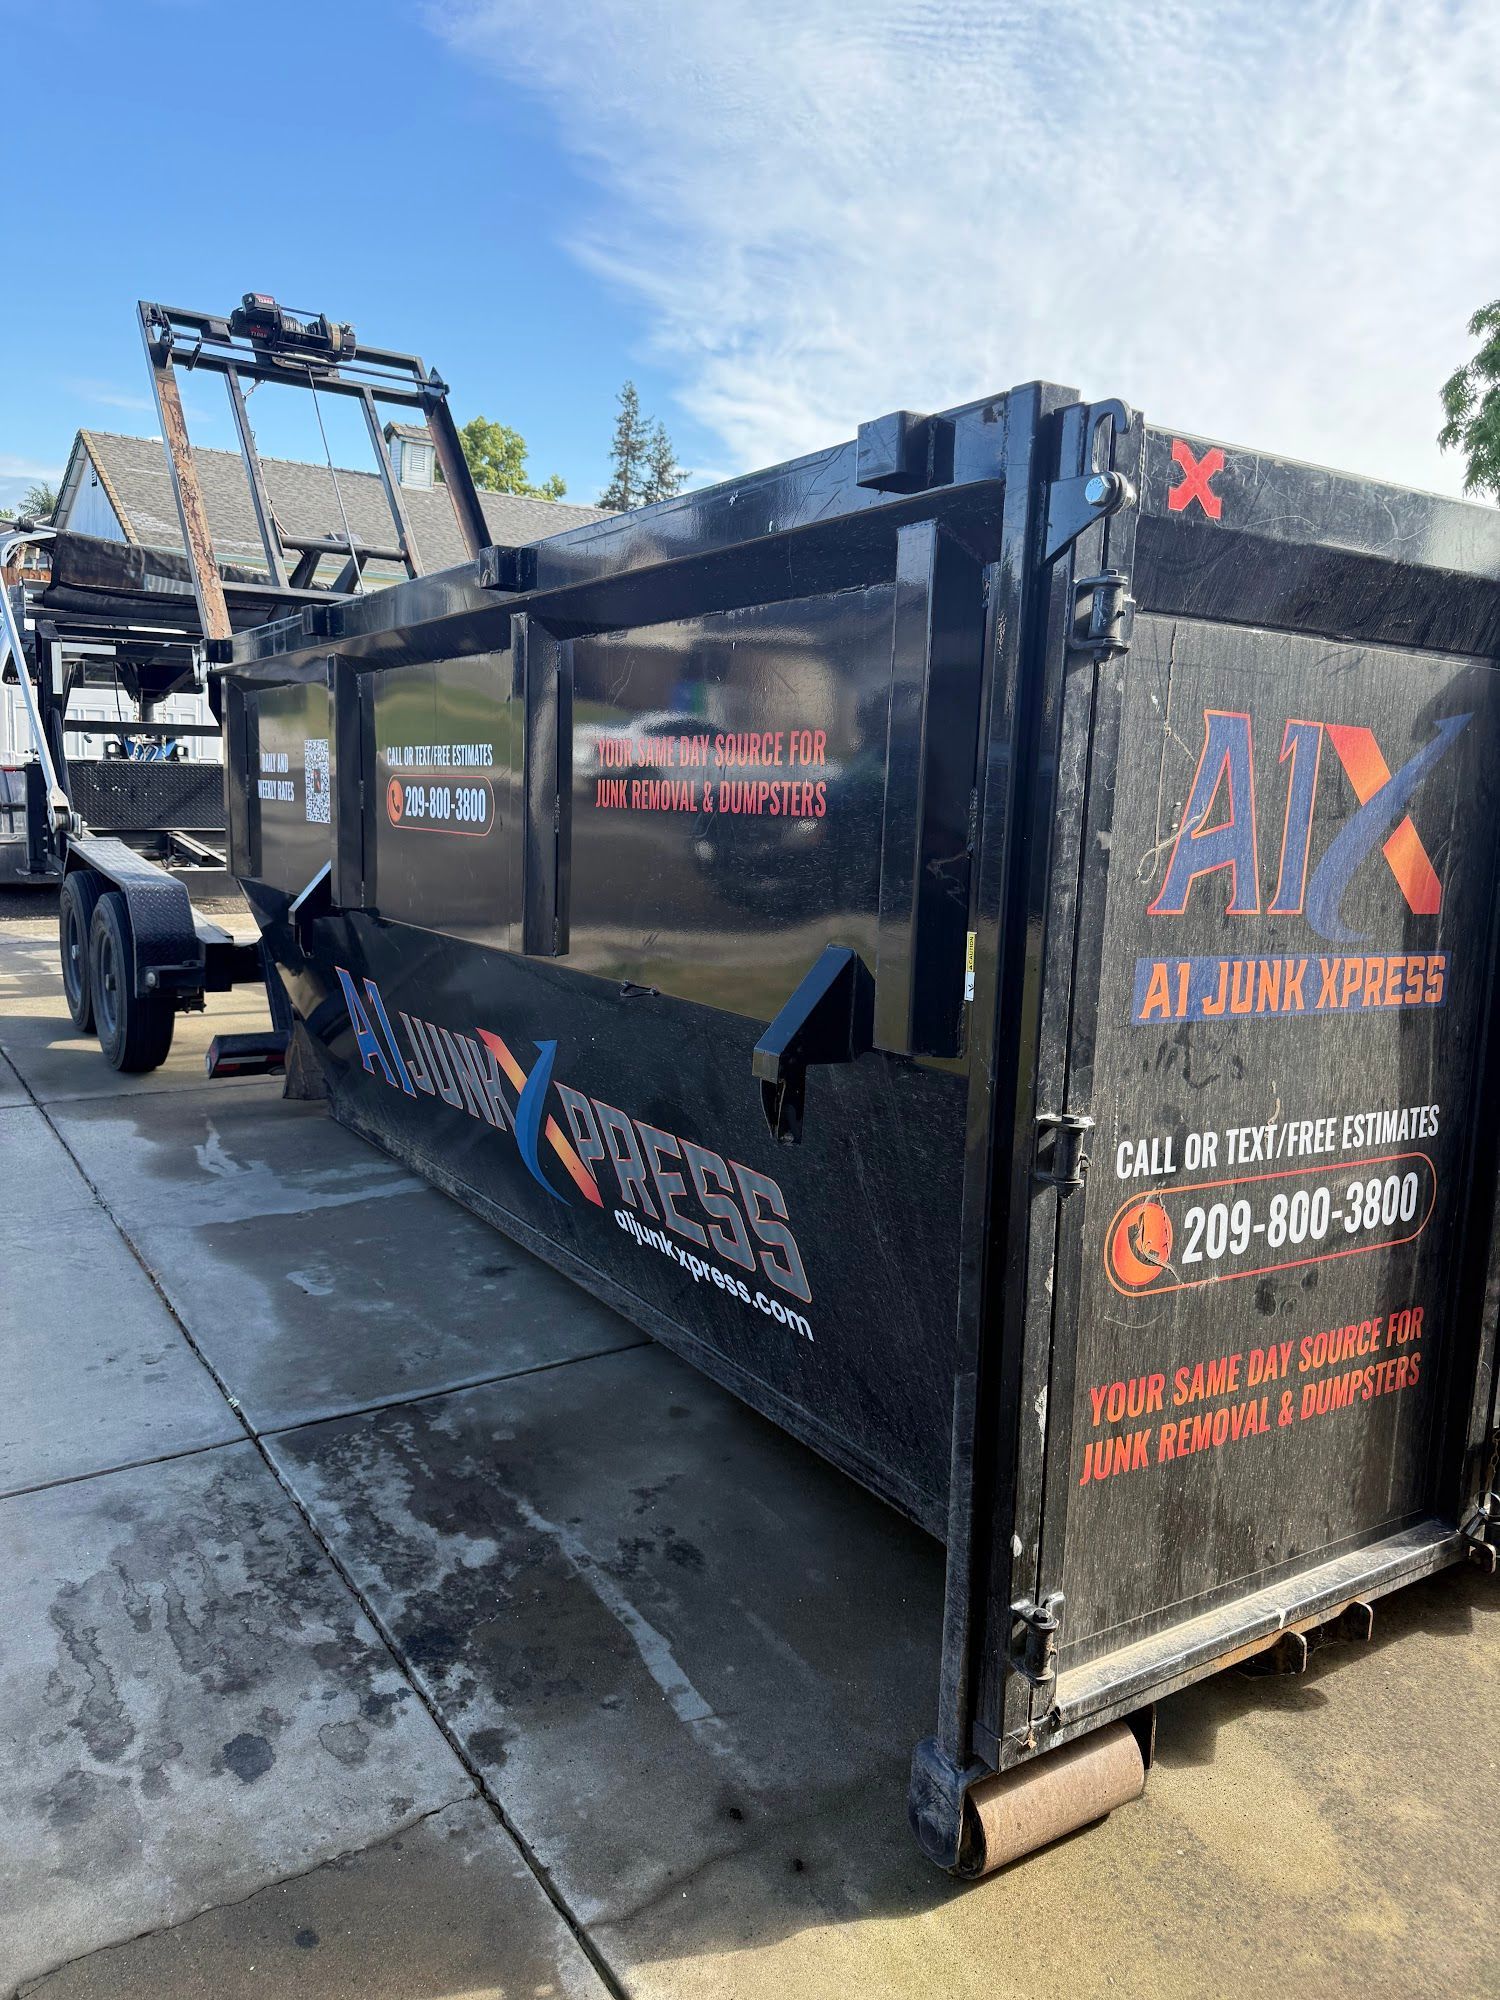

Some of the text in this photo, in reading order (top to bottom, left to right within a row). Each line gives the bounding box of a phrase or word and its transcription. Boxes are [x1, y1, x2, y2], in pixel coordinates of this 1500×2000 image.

[387, 743, 493, 767] CALL OR TEXT/FREE ESTIMATES
[597, 729, 827, 768] YOUR SAME DAY SOURCE FOR
[257, 779, 295, 802] WEEKLY RATES
[405, 785, 486, 823] 209-800-3800
[596, 778, 827, 818] JUNK REMOVAL & DUMPSTERS
[1139, 954, 1447, 1020] A1 JUNK XPRESS
[335, 965, 813, 1304] A1 JUNK XPRESS
[1116, 1104, 1440, 1179] CALL OR TEXT/FREE ESTIMATES
[1182, 1171, 1418, 1265] 209-800-3800
[614, 1209, 815, 1342] a1junkxpress.com
[1089, 1306, 1424, 1427] YOUR SAME DAY SOURCE FOR
[1079, 1351, 1423, 1486] JUNK REMOVAL & DUMPSTERS
